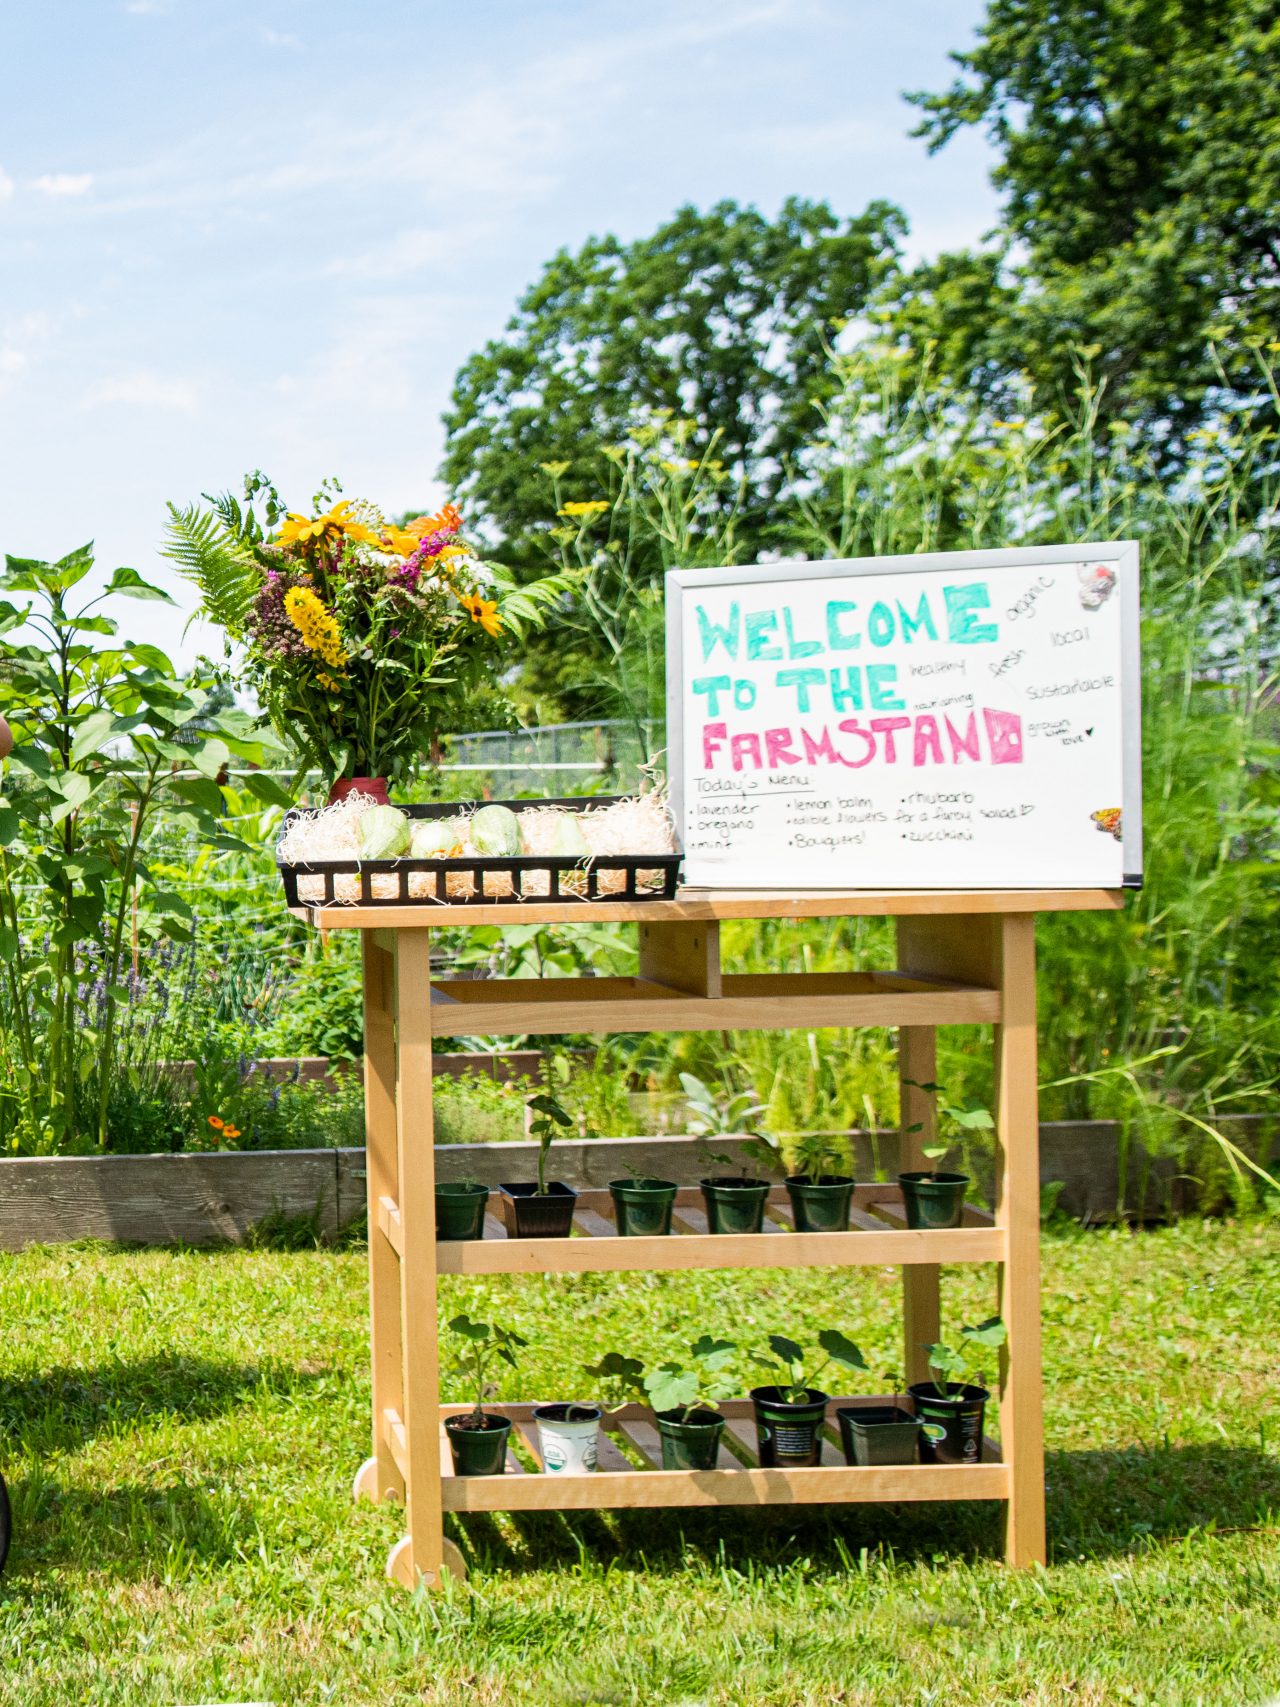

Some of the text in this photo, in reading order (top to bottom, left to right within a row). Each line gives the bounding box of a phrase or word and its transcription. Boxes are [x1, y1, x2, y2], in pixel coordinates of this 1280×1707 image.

[1006, 576, 1055, 621] organic
[695, 582, 998, 664] WELCOME
[1049, 626, 1090, 647] local
[988, 649, 1027, 679] fresh
[692, 664, 906, 717] TO THE
[1027, 719, 1071, 738] grown
[703, 707, 1024, 771] FARMSTAND
[793, 796, 873, 811] lemon balm
[907, 791, 975, 805] rhubarb
[696, 803, 760, 816] lavender
[696, 819, 755, 839] oregano
[909, 828, 975, 842] zucchini
[697, 840, 733, 850] mint
